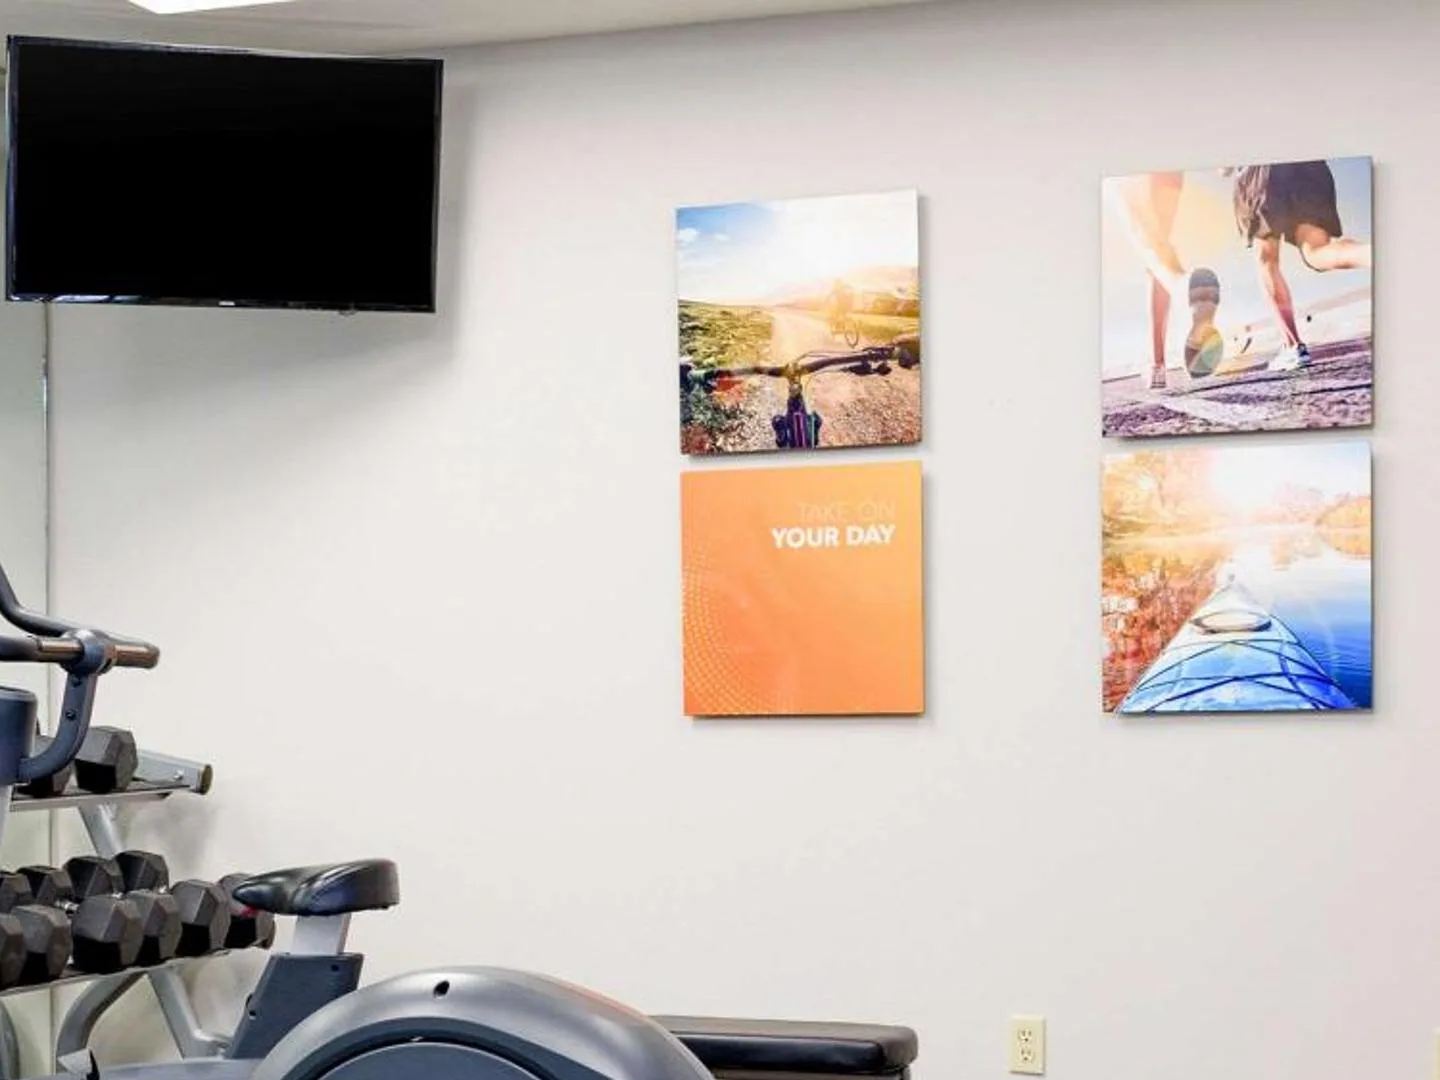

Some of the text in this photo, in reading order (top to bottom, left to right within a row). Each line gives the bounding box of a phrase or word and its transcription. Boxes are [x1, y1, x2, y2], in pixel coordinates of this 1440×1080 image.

[798, 499, 896, 523] TAKE ON
[771, 523, 896, 549] YOUR DAY
